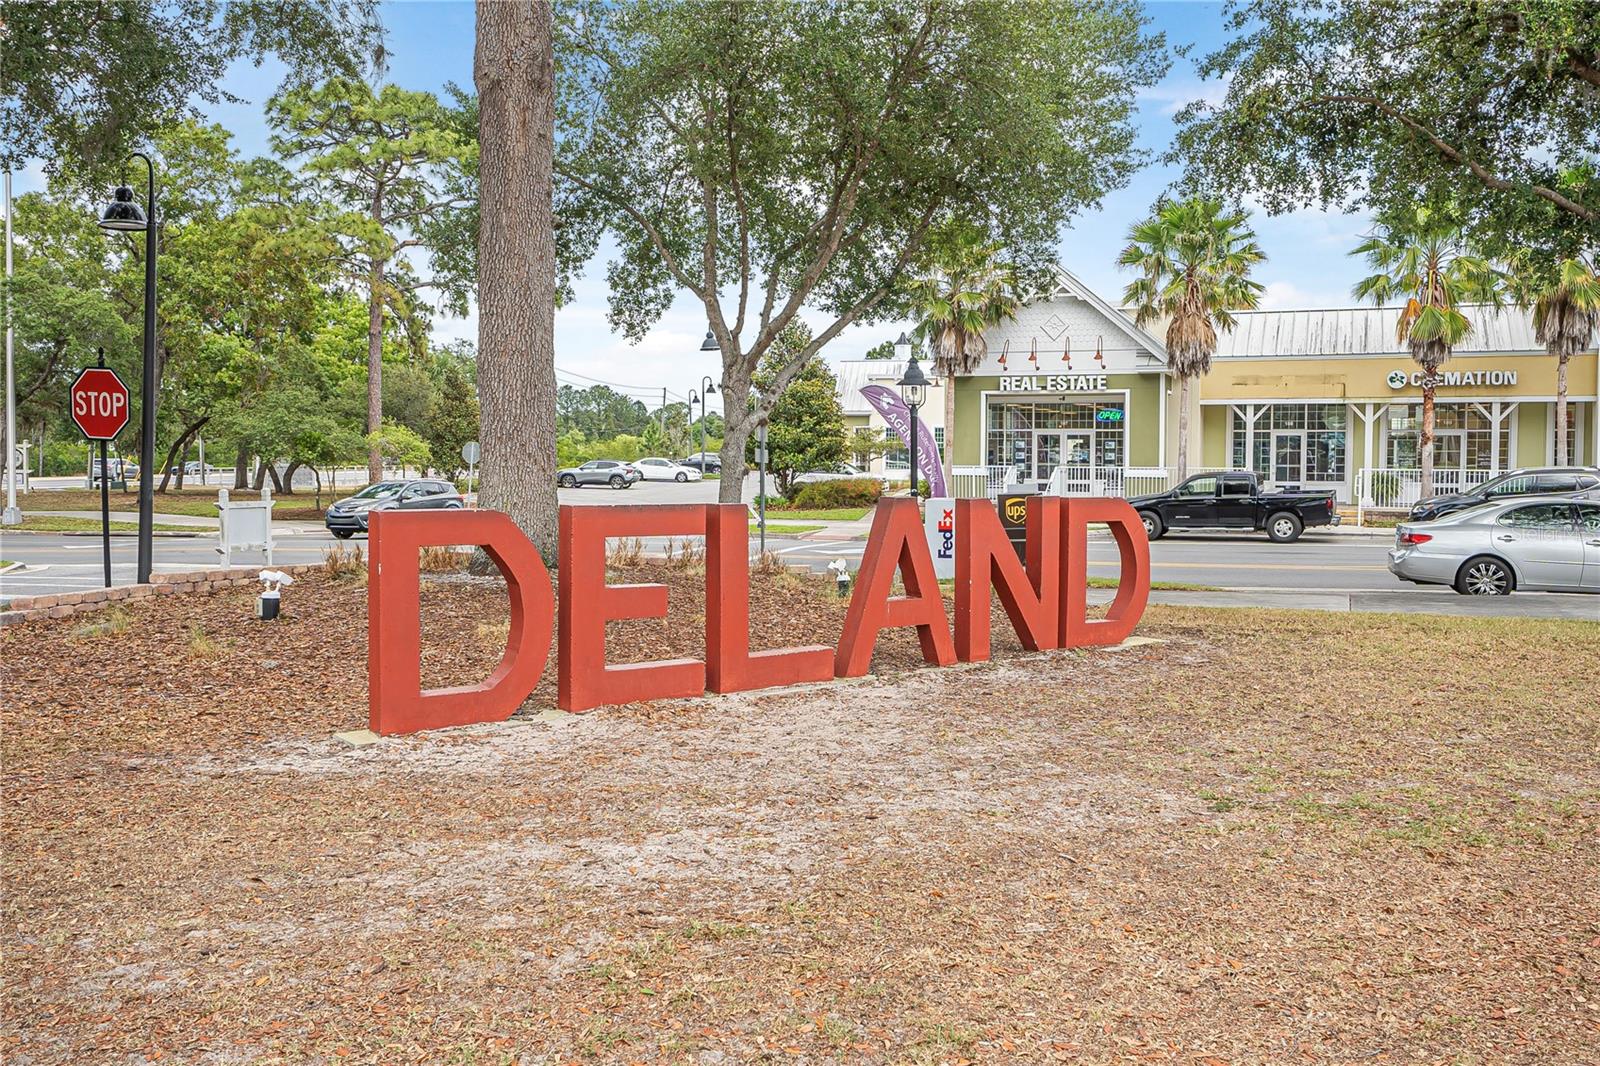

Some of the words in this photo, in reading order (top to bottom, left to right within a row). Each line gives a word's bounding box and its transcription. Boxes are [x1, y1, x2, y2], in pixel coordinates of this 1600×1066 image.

[999, 376, 1041, 391] REAL
[1046, 375, 1107, 391] ESTATE
[1410, 370, 1517, 386] CEMATION
[76, 391, 124, 417] STOP
[1098, 411, 1121, 420] OPEN
[888, 413, 912, 442] AGEN
[1007, 505, 1026, 519] ups
[938, 509, 953, 558] FedEx
[368, 497, 1150, 735] DELAND
